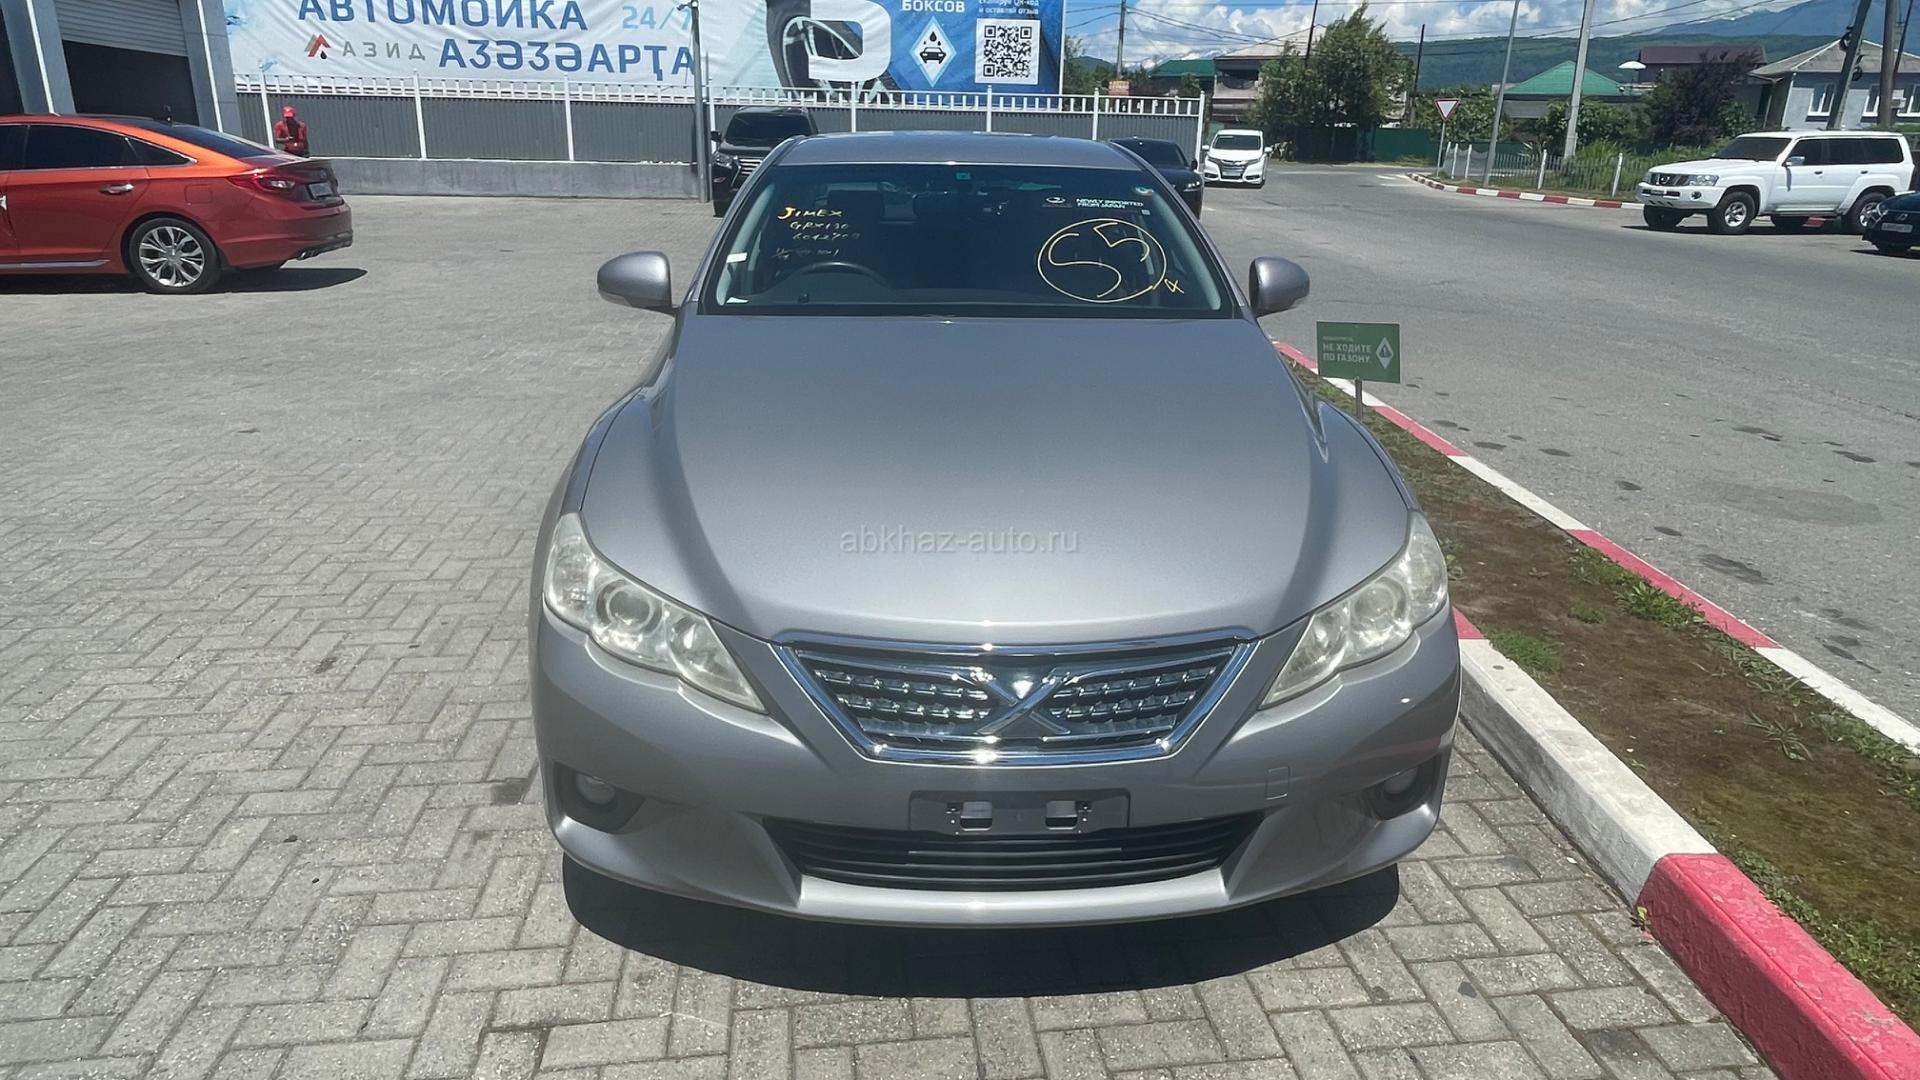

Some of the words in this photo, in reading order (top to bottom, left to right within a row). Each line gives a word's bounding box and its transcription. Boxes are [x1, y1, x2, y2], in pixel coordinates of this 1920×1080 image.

[901, 0, 966, 13] БОКСОВ
[342, 41, 426, 60] АЗИД
[1322, 343, 1334, 352] НЕ
[1336, 343, 1373, 354] ХОДИТЕ
[1322, 352, 1335, 361] ПО
